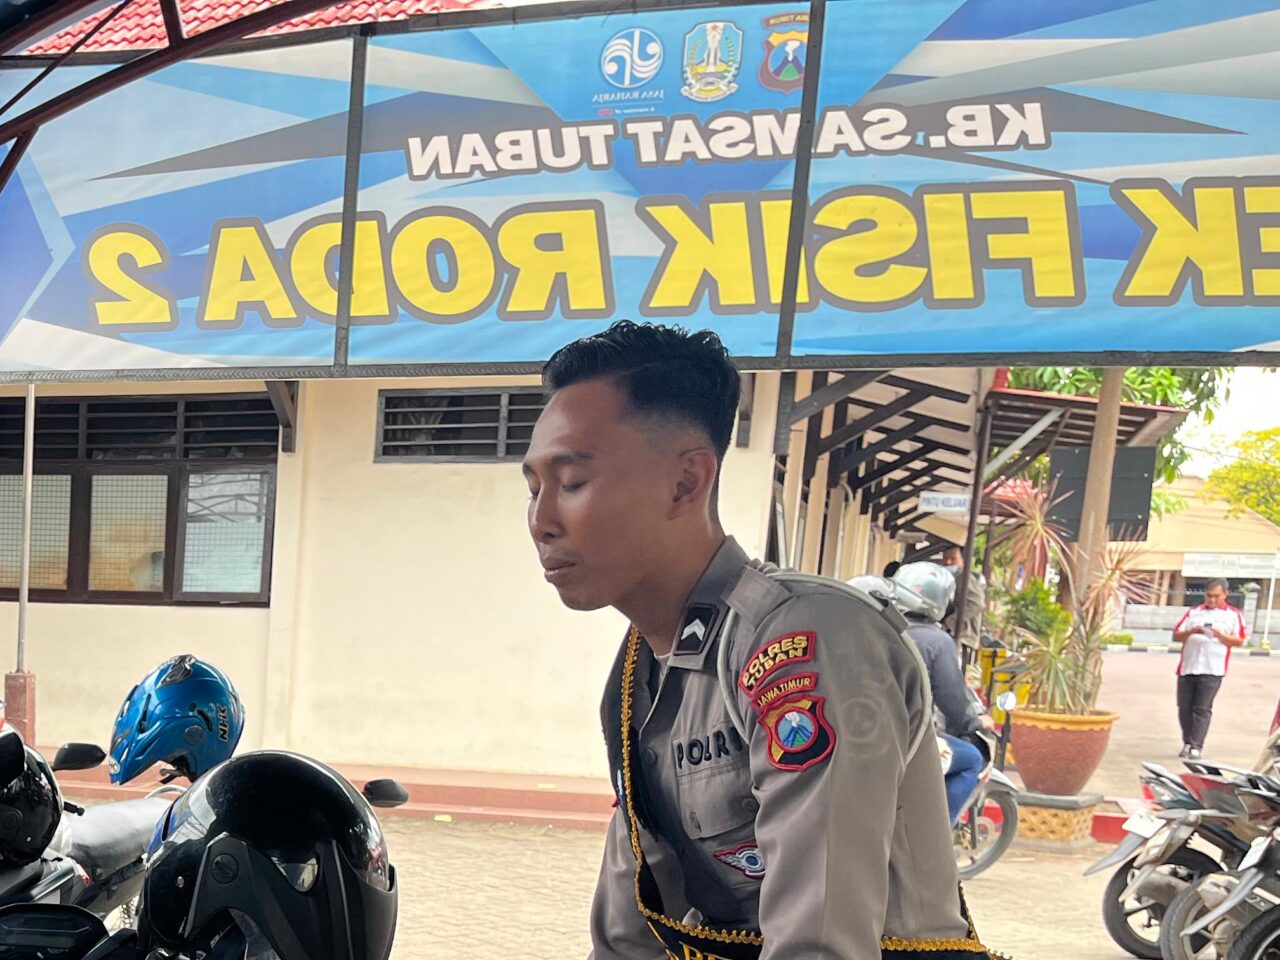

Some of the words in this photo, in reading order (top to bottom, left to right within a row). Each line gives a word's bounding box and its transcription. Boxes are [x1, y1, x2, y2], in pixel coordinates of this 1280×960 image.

[742, 635, 808, 688] POLRES
[747, 648, 803, 687] TUBAN
[757, 686, 780, 708] JAWA
[780, 677, 811, 693] TIMUR
[217, 703, 230, 743] NHK
[677, 726, 743, 770] POLRI
